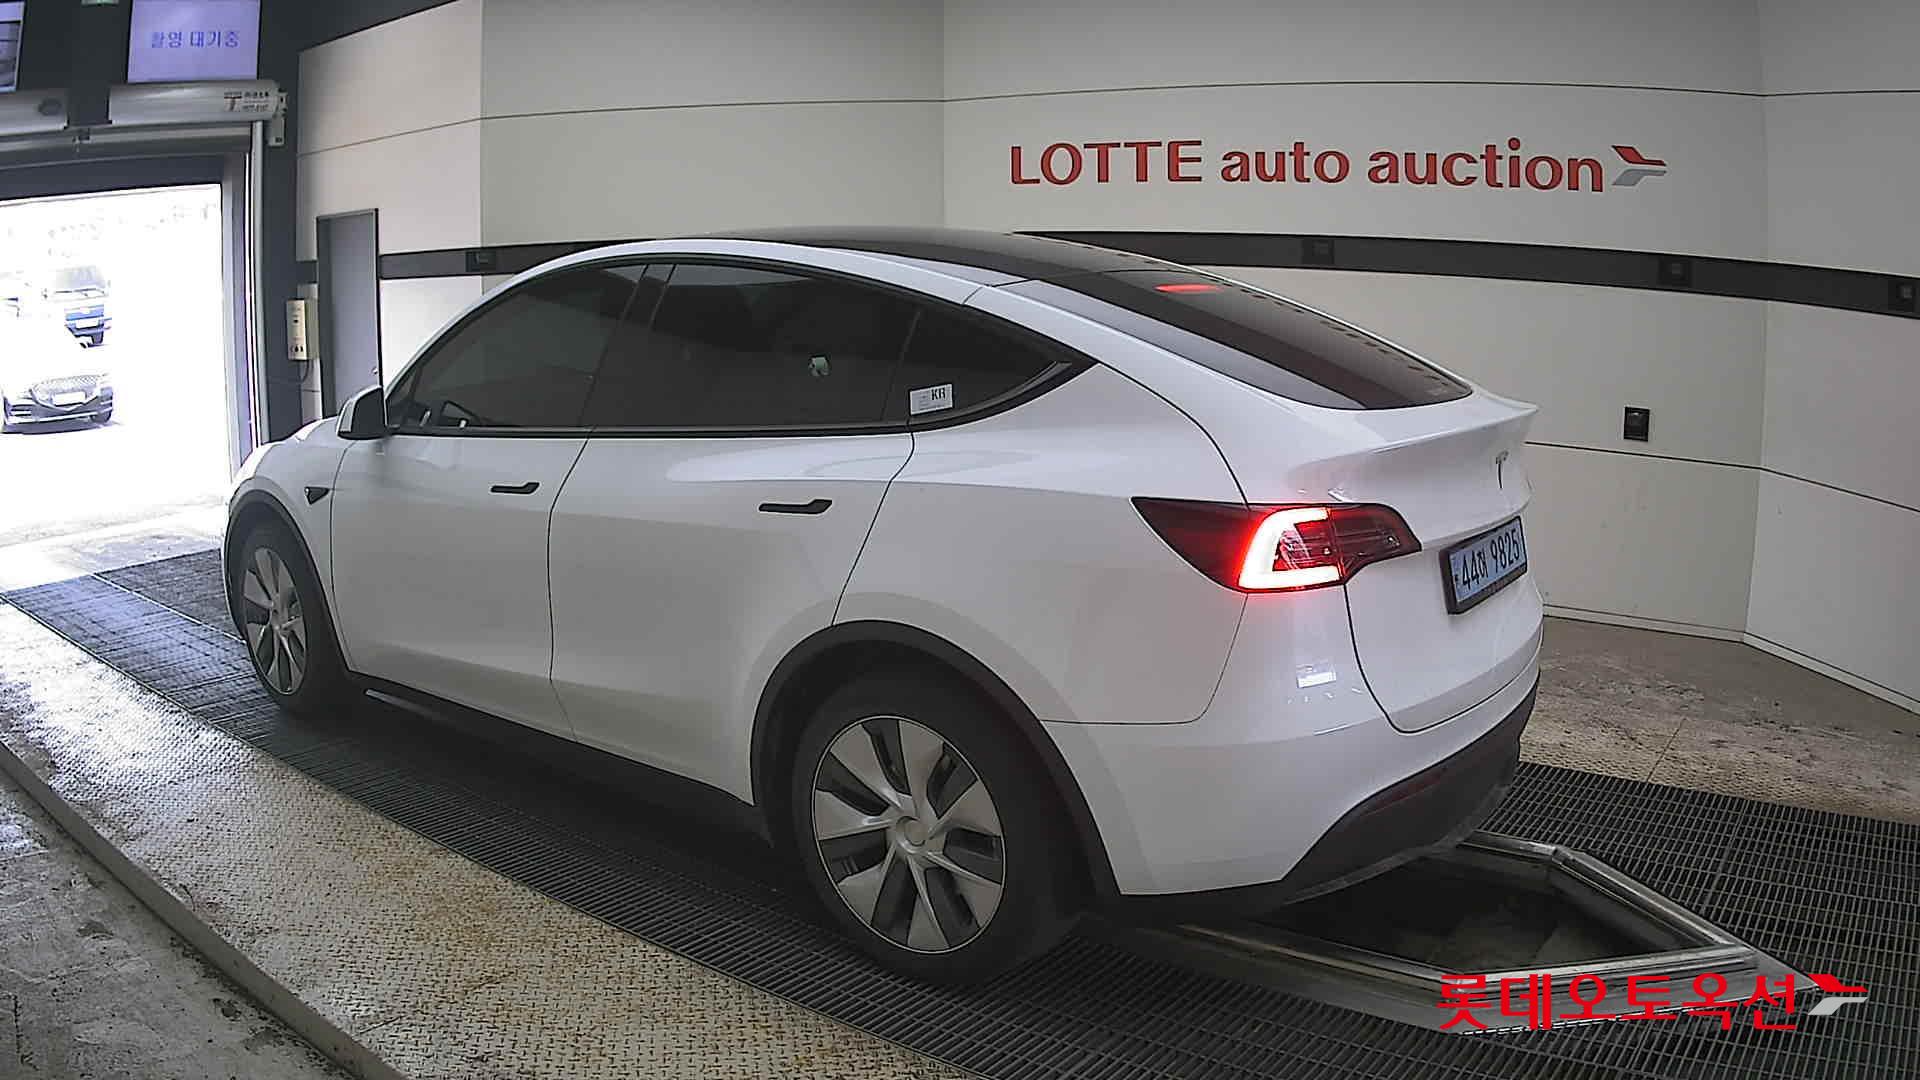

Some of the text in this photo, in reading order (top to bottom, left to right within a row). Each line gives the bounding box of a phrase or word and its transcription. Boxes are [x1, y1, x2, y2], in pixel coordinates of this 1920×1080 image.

[189, 30, 240, 49] 대기중
[1010, 136, 1604, 193] LOTTE auto auction
[1490, 527, 1520, 574] 9825
